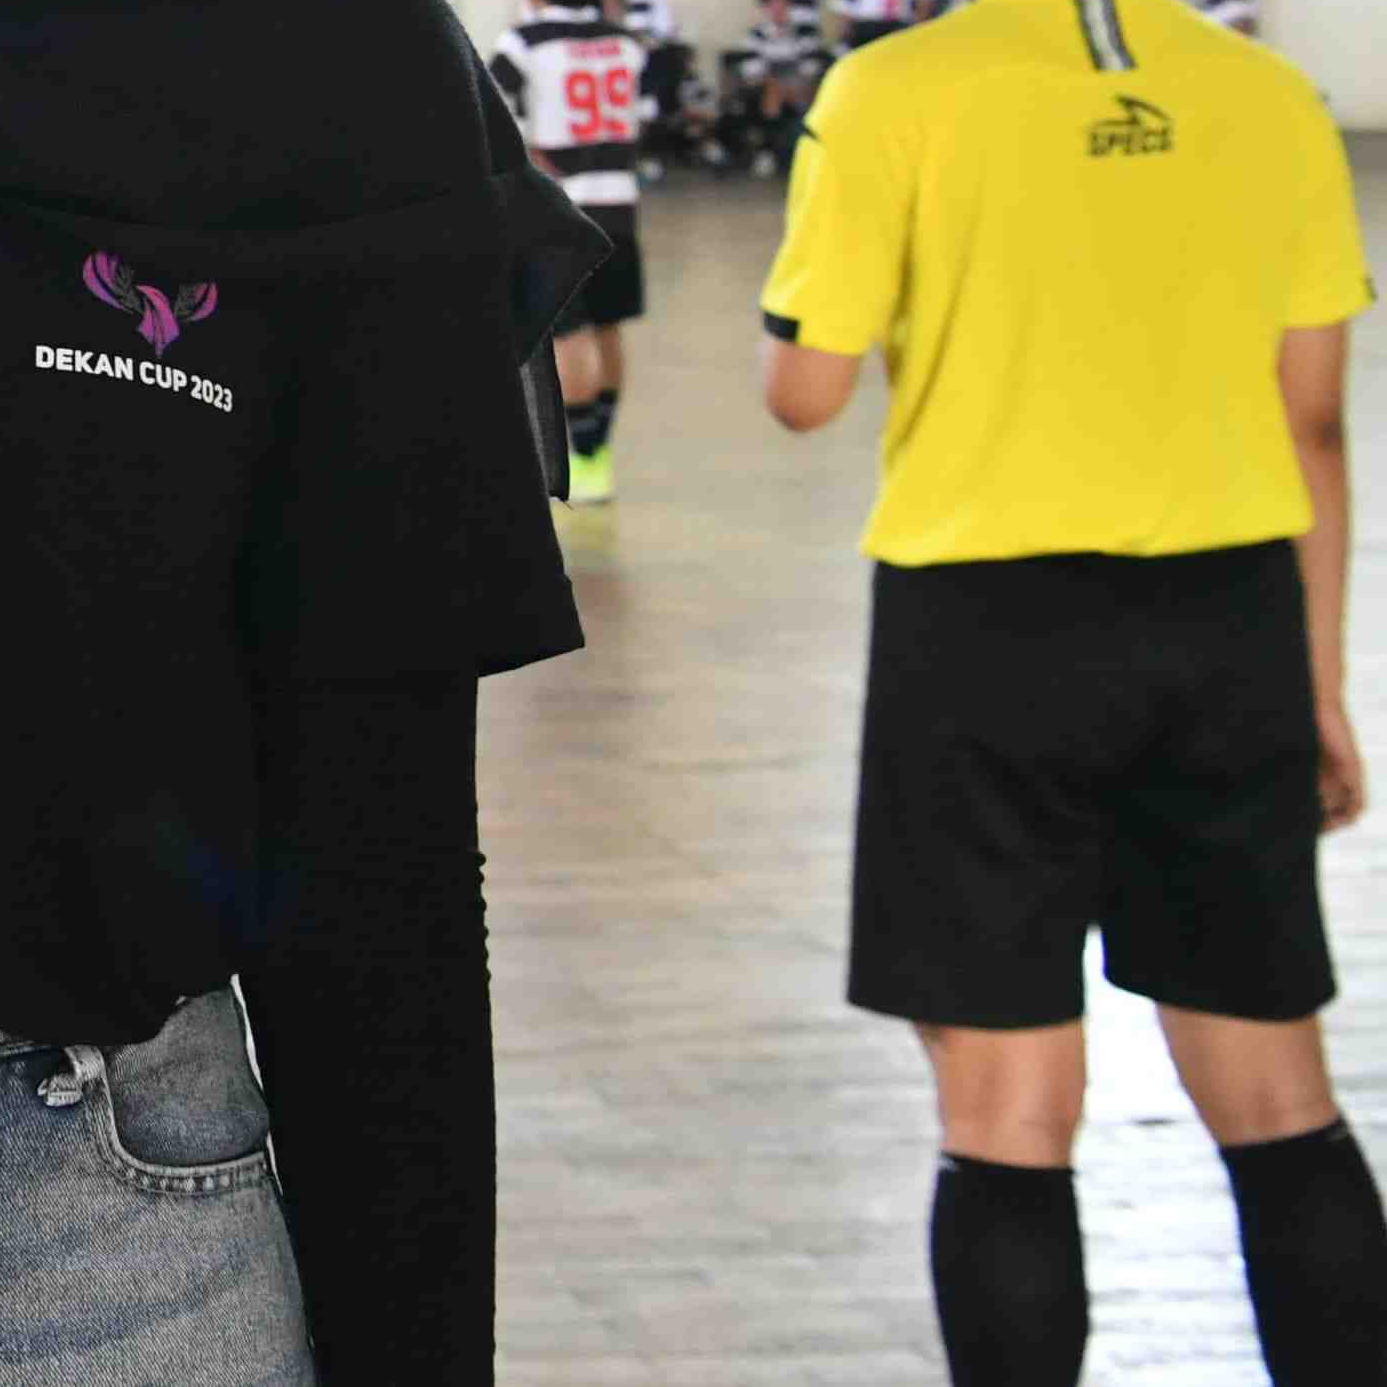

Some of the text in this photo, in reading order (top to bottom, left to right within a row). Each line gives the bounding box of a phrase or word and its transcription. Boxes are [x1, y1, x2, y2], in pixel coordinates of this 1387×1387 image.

[565, 67, 634, 143] 99
[1088, 130, 1174, 156] SPECS
[35, 345, 233, 413] DEKAN CUP 2023
